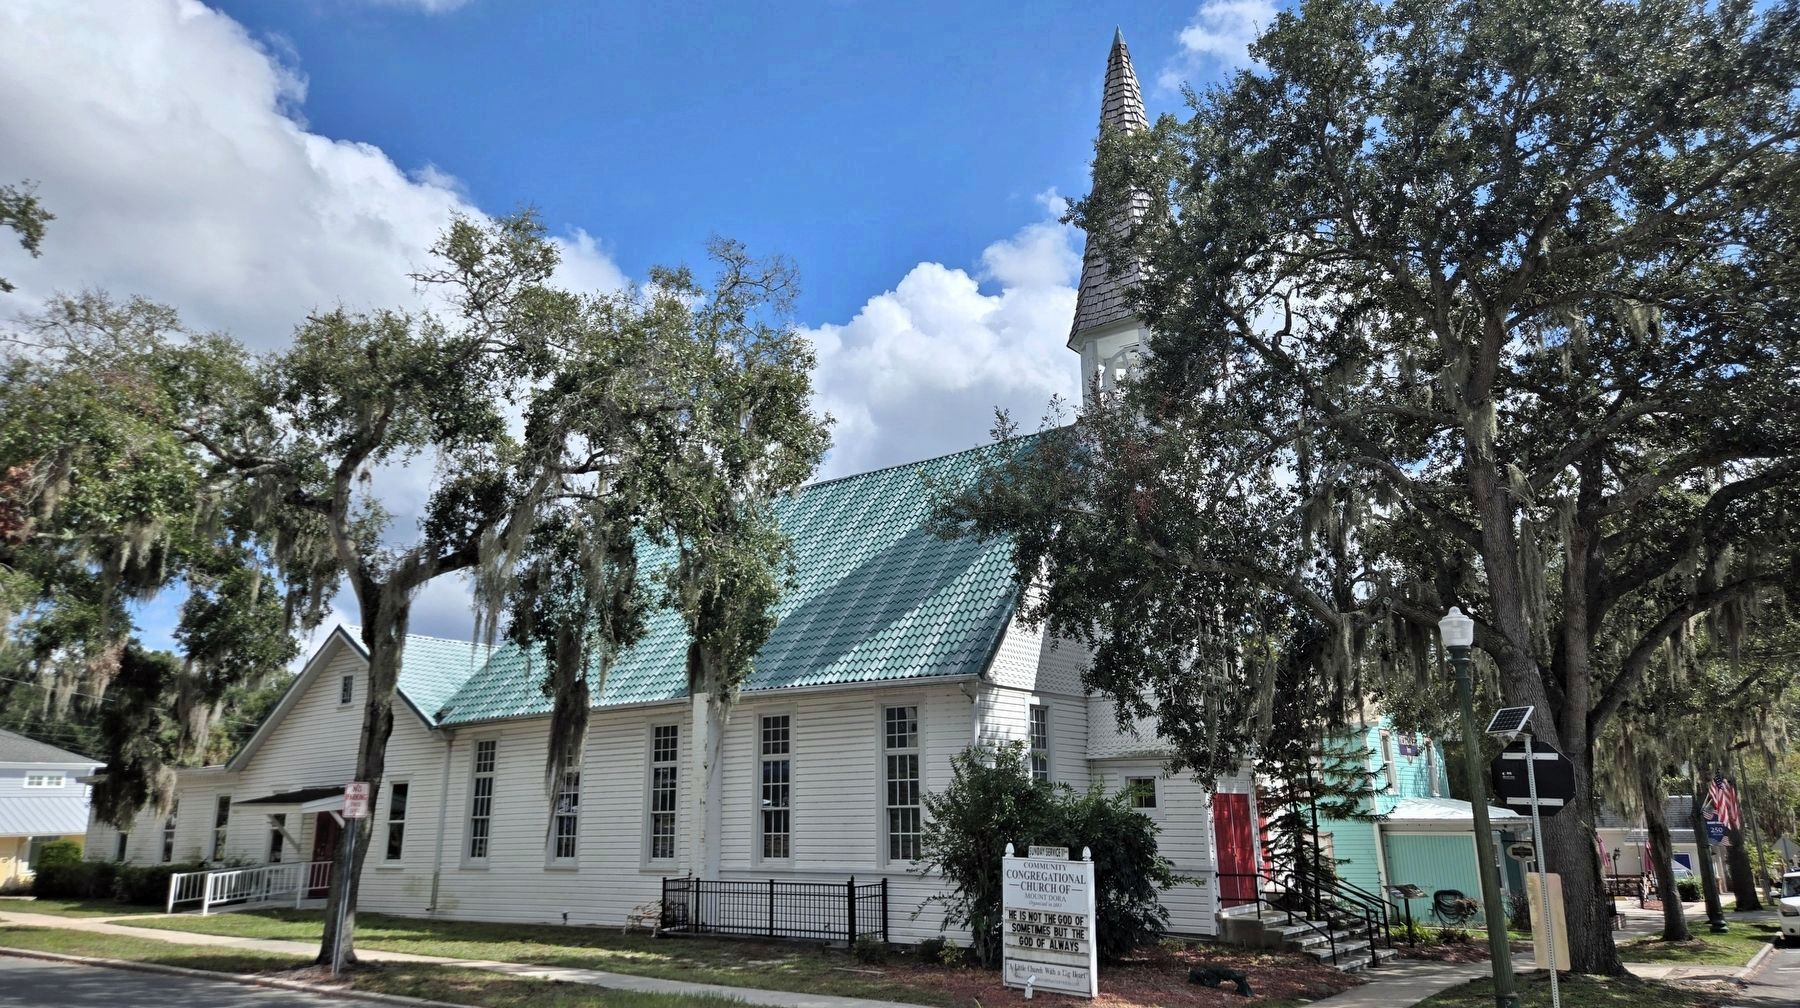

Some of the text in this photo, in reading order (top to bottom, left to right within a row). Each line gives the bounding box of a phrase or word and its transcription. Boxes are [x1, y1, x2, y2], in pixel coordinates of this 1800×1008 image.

[352, 784, 362, 792] NO
[1024, 862, 1067, 871] COMMUNITY
[1006, 869, 1086, 884] CONGREGATIONAL
[1021, 881, 1071, 894] CHURCH OF
[1009, 910, 1084, 925] HE IS NOT THE GOD OF
[1012, 923, 1084, 939] SOMETIMES BUT THE
[1019, 936, 1079, 951] GOD OF ALWAYS
[1028, 965, 1043, 974] Church
